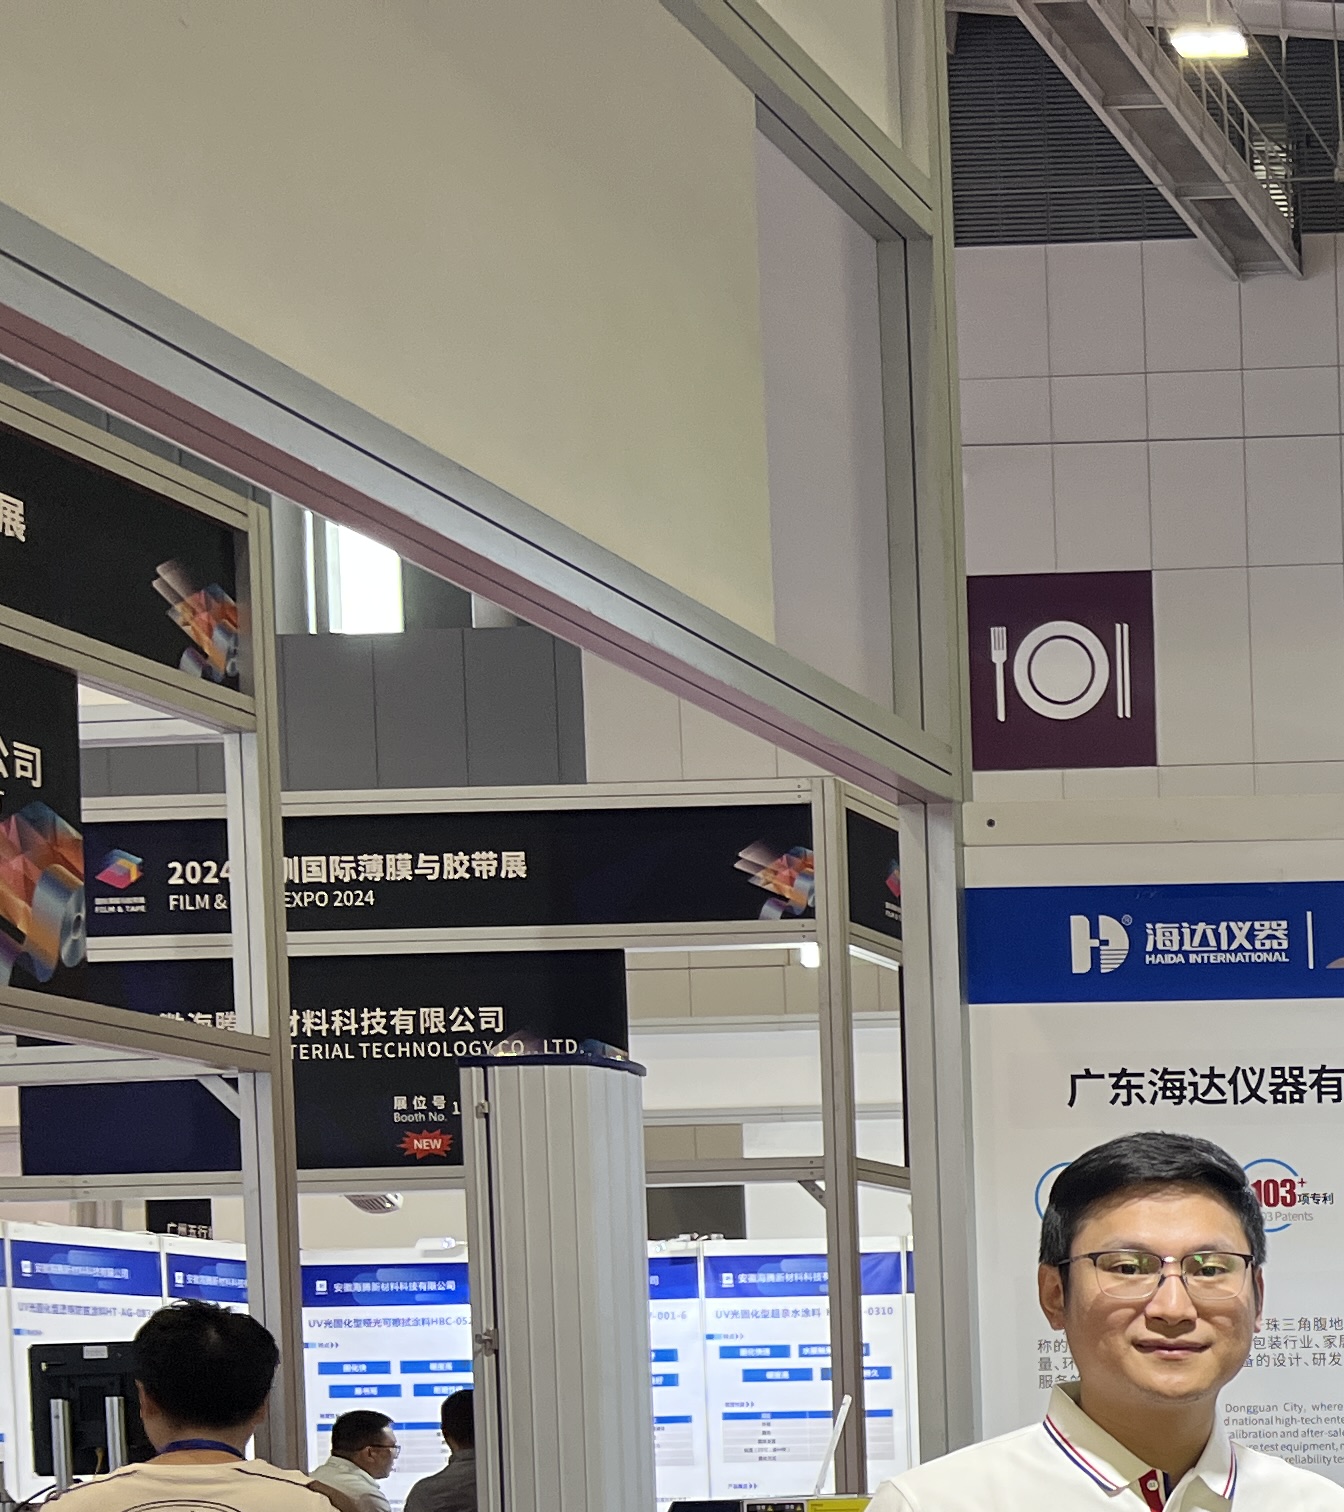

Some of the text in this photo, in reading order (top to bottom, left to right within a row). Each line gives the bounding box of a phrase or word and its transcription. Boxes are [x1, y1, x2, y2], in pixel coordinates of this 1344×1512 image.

[168, 893, 210, 911] FILM
[213, 893, 228, 910] &
[332, 889, 376, 908] 2024
[1145, 919, 1289, 953] 海达仪器
[1145, 950, 1290, 965] HAIDA INTERNATIONAL
[360, 1040, 494, 1059] TECHNOLOGY
[393, 1111, 425, 1123] Booth
[428, 1111, 449, 1123] No.
[413, 1139, 442, 1152] NEW
[1297, 1192, 1335, 1206] 项专利
[1274, 1211, 1314, 1222] Patents
[1225, 1402, 1278, 1415] Dongguan
[1283, 1401, 1307, 1414] City,
[1311, 1401, 1344, 1412] where
[1231, 1415, 1274, 1427] national
[1275, 1415, 1323, 1428] high-tech
[1280, 1428, 1299, 1438] and
[1260, 1440, 1279, 1451] test
